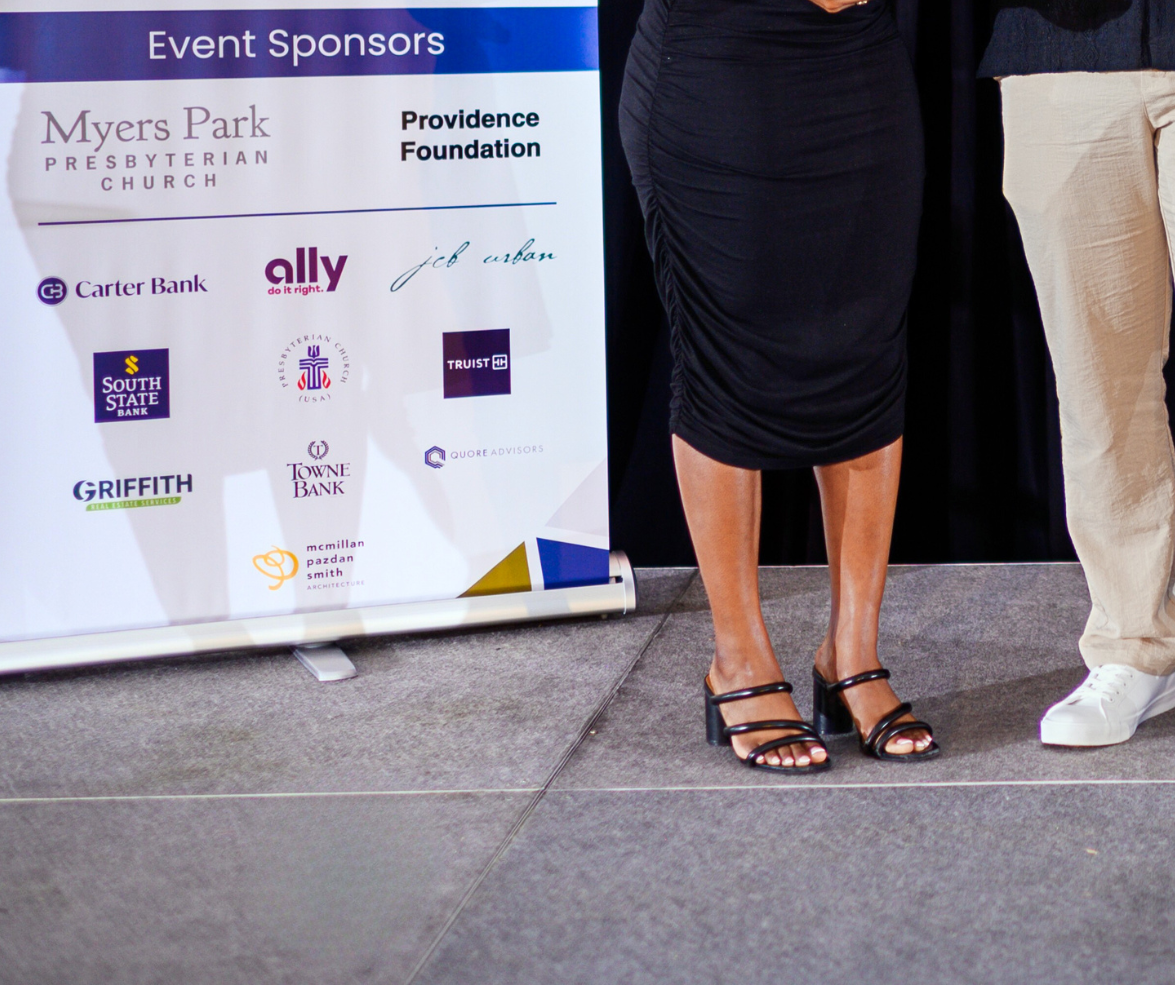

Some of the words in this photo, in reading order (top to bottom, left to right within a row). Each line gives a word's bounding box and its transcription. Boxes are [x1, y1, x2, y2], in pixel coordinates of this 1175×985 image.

[148, 28, 256, 61] Event
[268, 27, 445, 66] Sponsors
[40, 108, 171, 152] Myers
[182, 104, 271, 141] Park
[400, 109, 540, 132] Providence
[400, 139, 541, 162] Foundation
[44, 149, 269, 173] PRESBYTERIAN
[100, 172, 218, 192] CHURCH
[265, 246, 348, 292] ally
[390, 241, 470, 292] jcb
[483, 238, 556, 265] urban
[75, 280, 145, 299] Carter
[151, 274, 208, 295] Bank
[267, 285, 281, 295] do
[283, 284, 292, 295] it
[294, 284, 324, 296] right.
[278, 334, 331, 388] PRESBYTERIAN
[334, 342, 350, 384] CHURCH
[447, 358, 490, 370] TRUIST
[298, 393, 331, 403] (USA)
[117, 407, 148, 417] BANK
[450, 449, 488, 460] QUORE
[490, 445, 544, 456] ADVISORS
[72, 473, 193, 502] GRIFFITH
[111, 500, 138, 509] ESTATE
[140, 497, 178, 507] SERVICES
[306, 539, 365, 552] mcmillan
[306, 554, 354, 568] pazdan
[306, 568, 343, 580] smith
[306, 580, 365, 591] ARCHITECTURE
